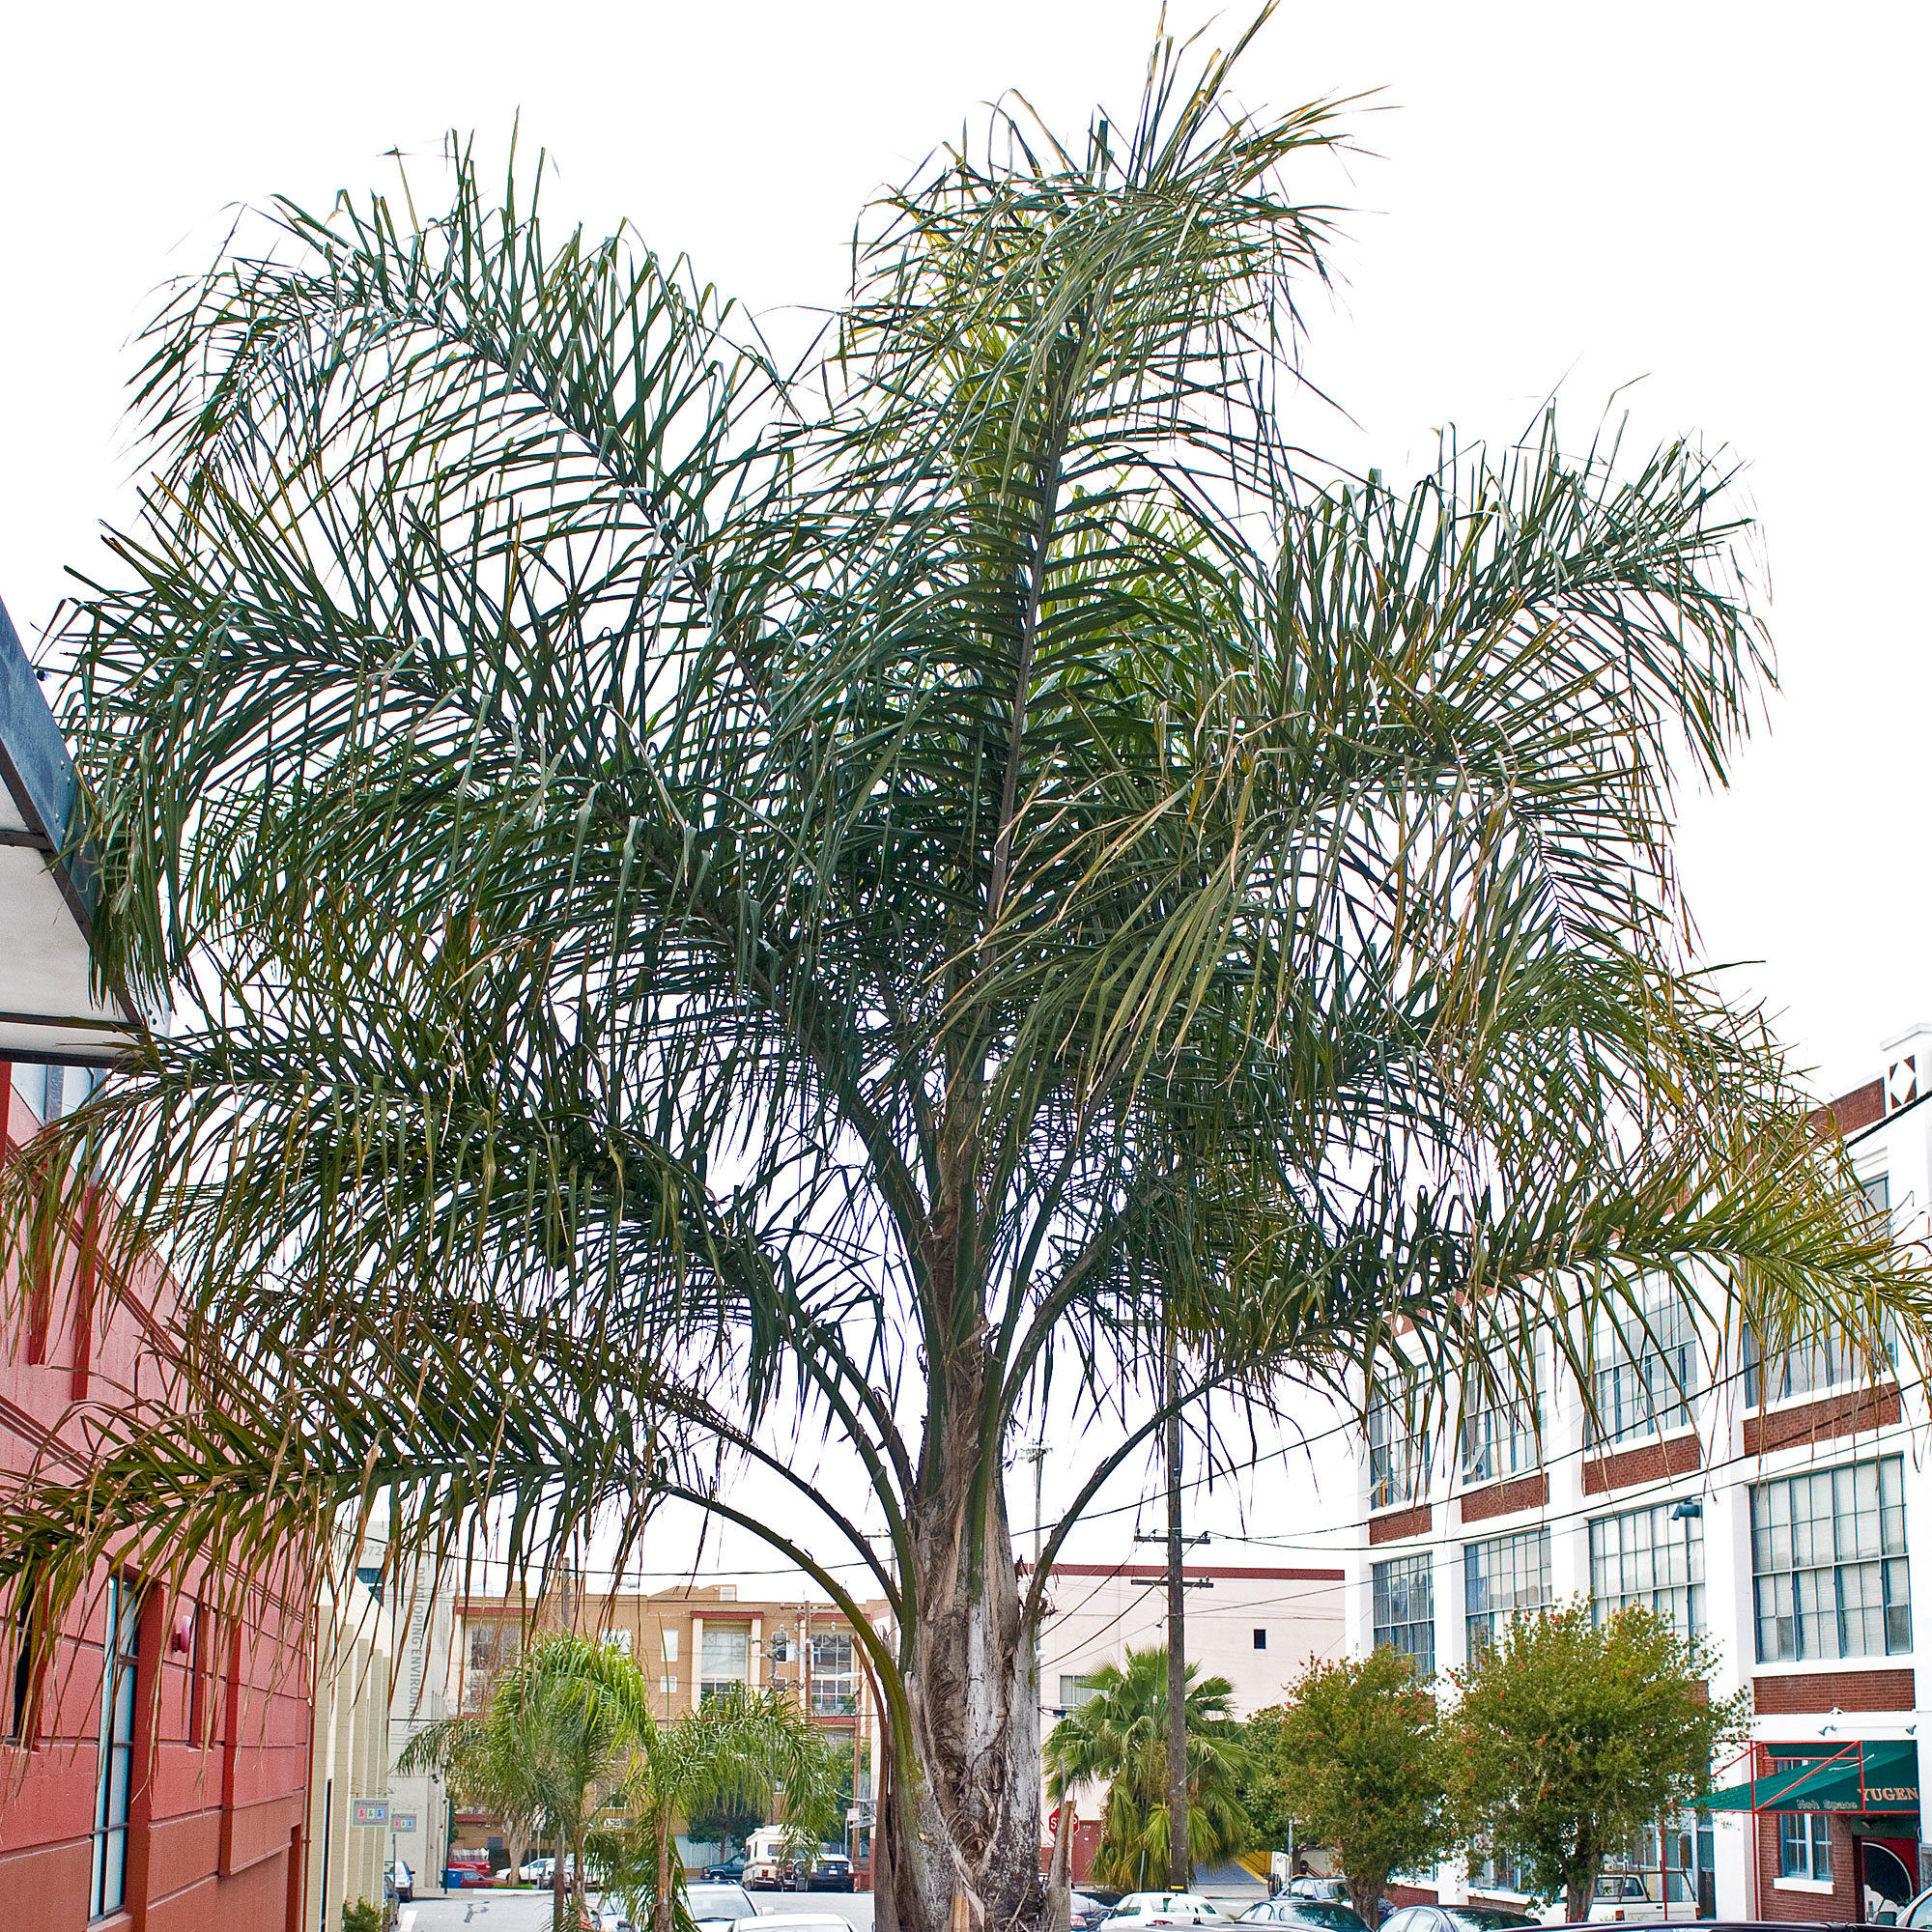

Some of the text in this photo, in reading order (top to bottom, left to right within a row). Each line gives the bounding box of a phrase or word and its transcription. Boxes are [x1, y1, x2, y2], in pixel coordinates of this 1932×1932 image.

[1857, 1787, 1919, 1802] YUGEN
[1823, 1800, 1858, 1811] Space
[1050, 1816, 1078, 1830] SP
